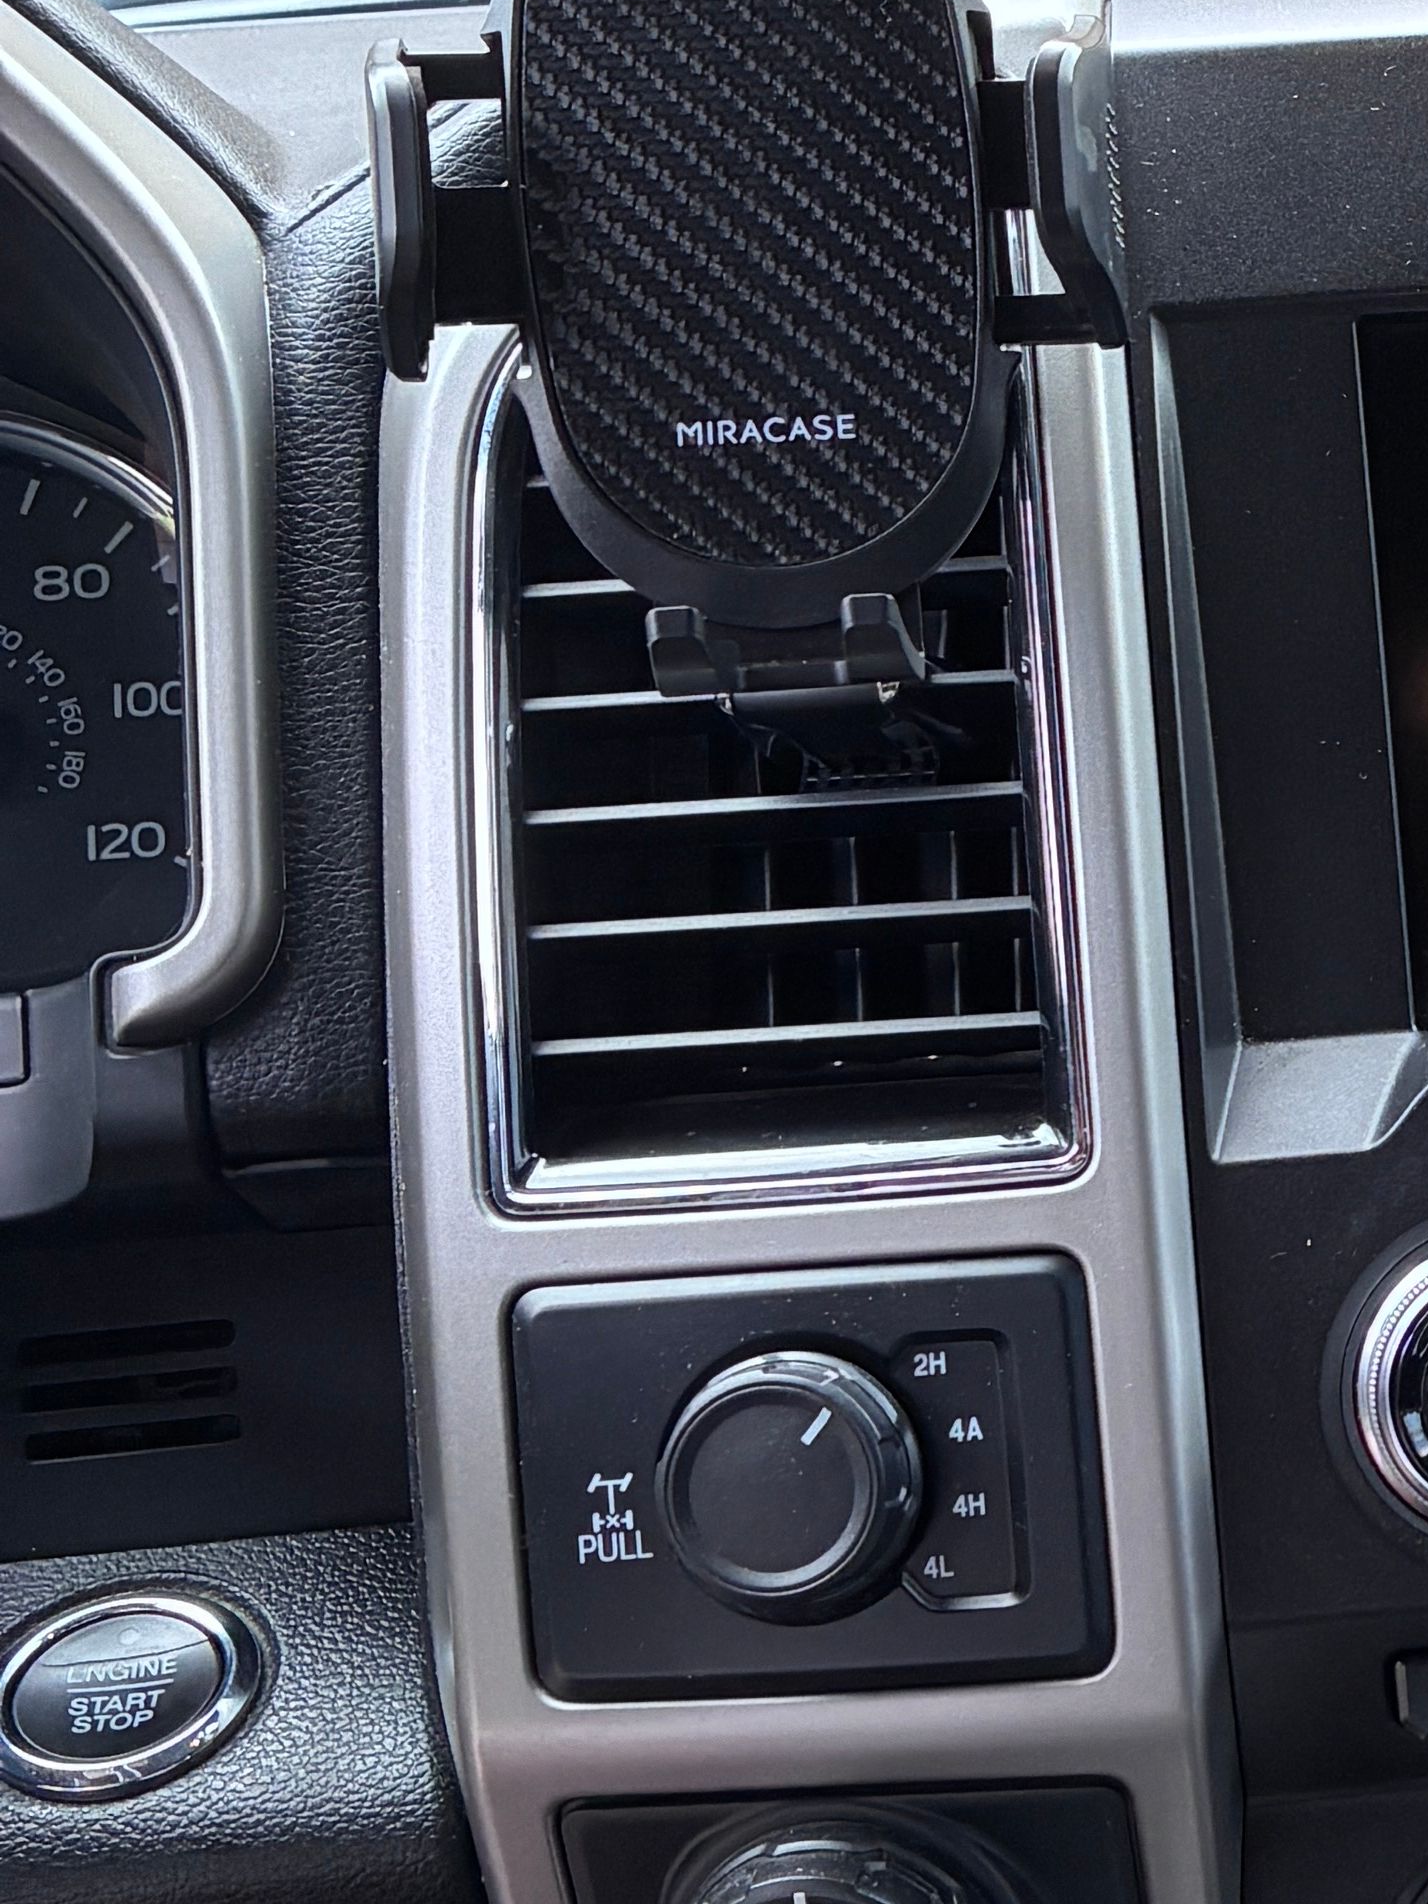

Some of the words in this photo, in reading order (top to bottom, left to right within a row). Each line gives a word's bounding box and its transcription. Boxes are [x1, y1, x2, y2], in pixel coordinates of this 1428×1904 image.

[676, 413, 857, 447] MIRACASE
[33, 563, 110, 601] 80
[27, 649, 66, 687] 140
[57, 697, 85, 735] 160
[58, 751, 86, 789] 180
[87, 821, 166, 861] 120
[913, 1351, 947, 1377] 2H
[948, 1416, 984, 1443] 4A
[952, 1492, 986, 1518] 4H
[577, 1530, 654, 1564] PULL
[923, 1555, 955, 1579] 4L
[66, 1654, 178, 1684] ENGINE
[67, 1688, 166, 1716] START
[71, 1709, 154, 1734] STOP
